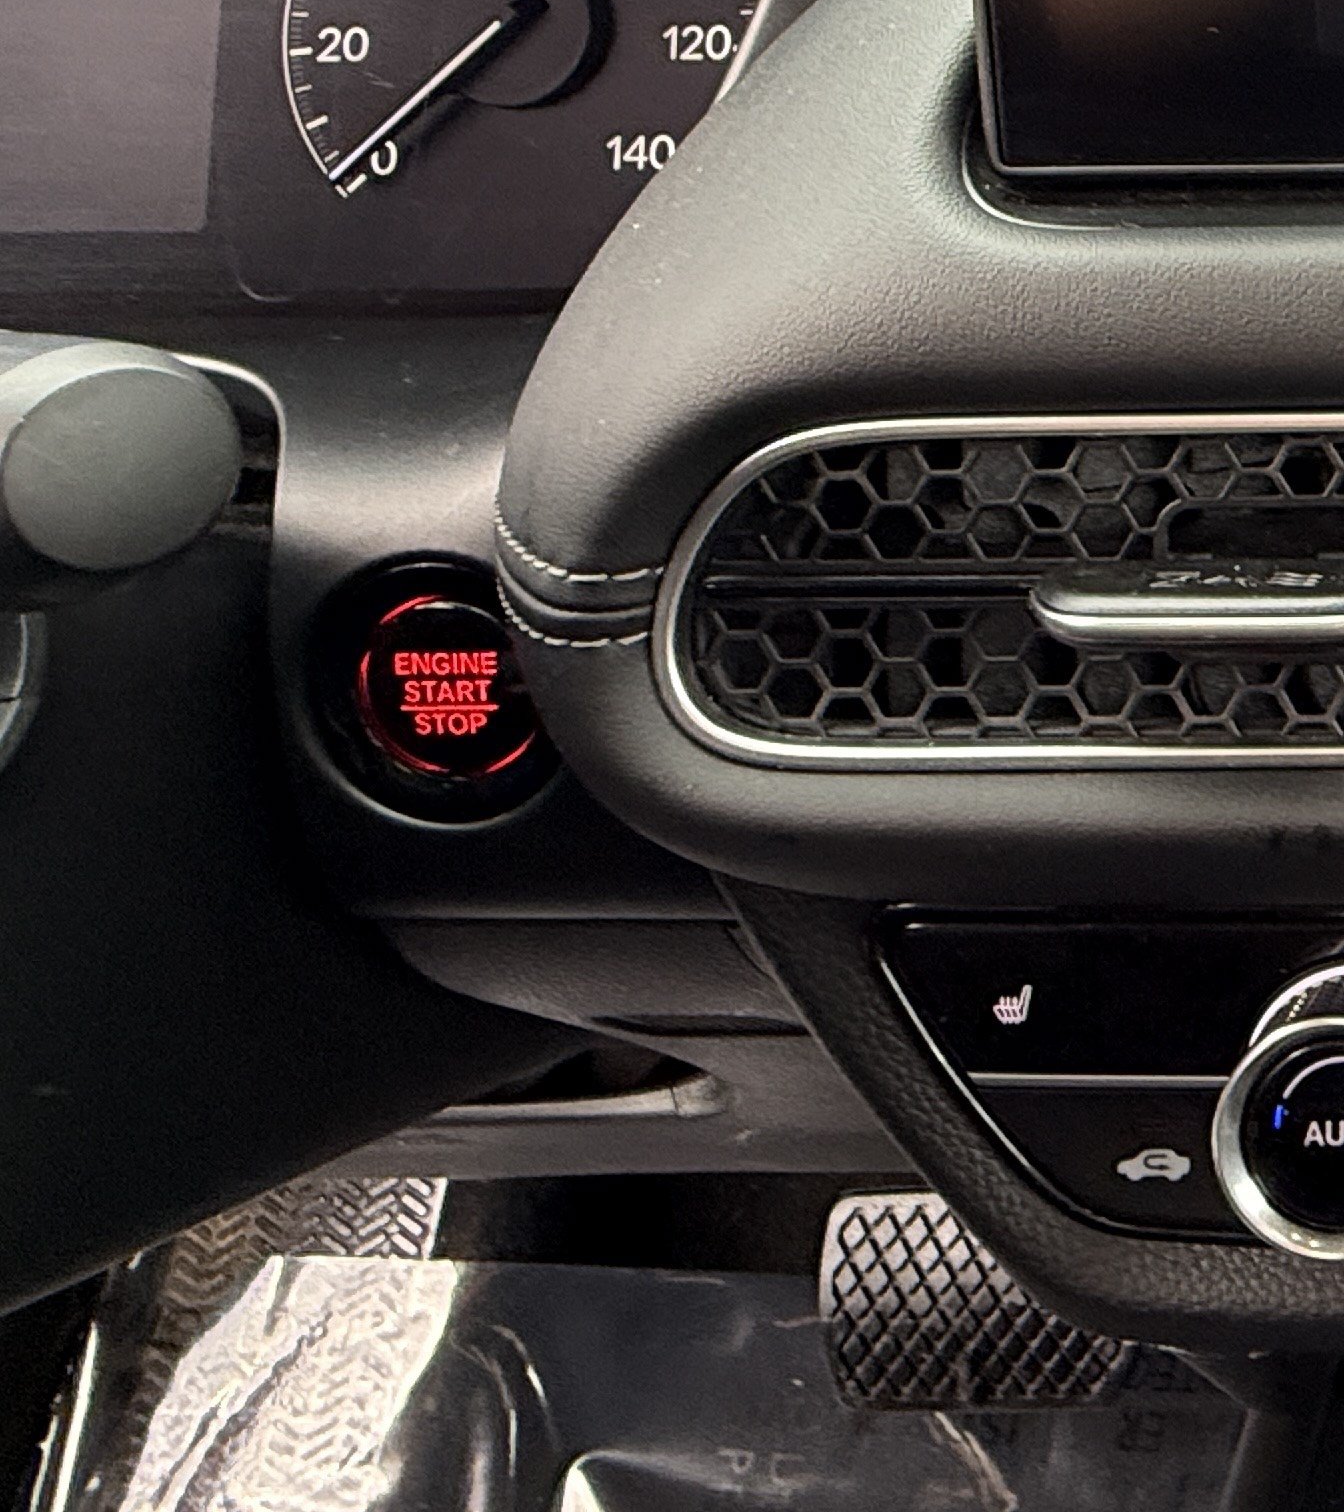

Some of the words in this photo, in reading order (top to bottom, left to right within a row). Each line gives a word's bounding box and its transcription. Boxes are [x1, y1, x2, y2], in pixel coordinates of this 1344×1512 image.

[316, 26, 370, 63] 20
[662, 24, 732, 61] 120
[370, 138, 399, 178] 0
[606, 133, 677, 172] 140
[394, 651, 497, 676] ENGINE
[404, 679, 490, 703] START
[414, 713, 488, 736] STOP
